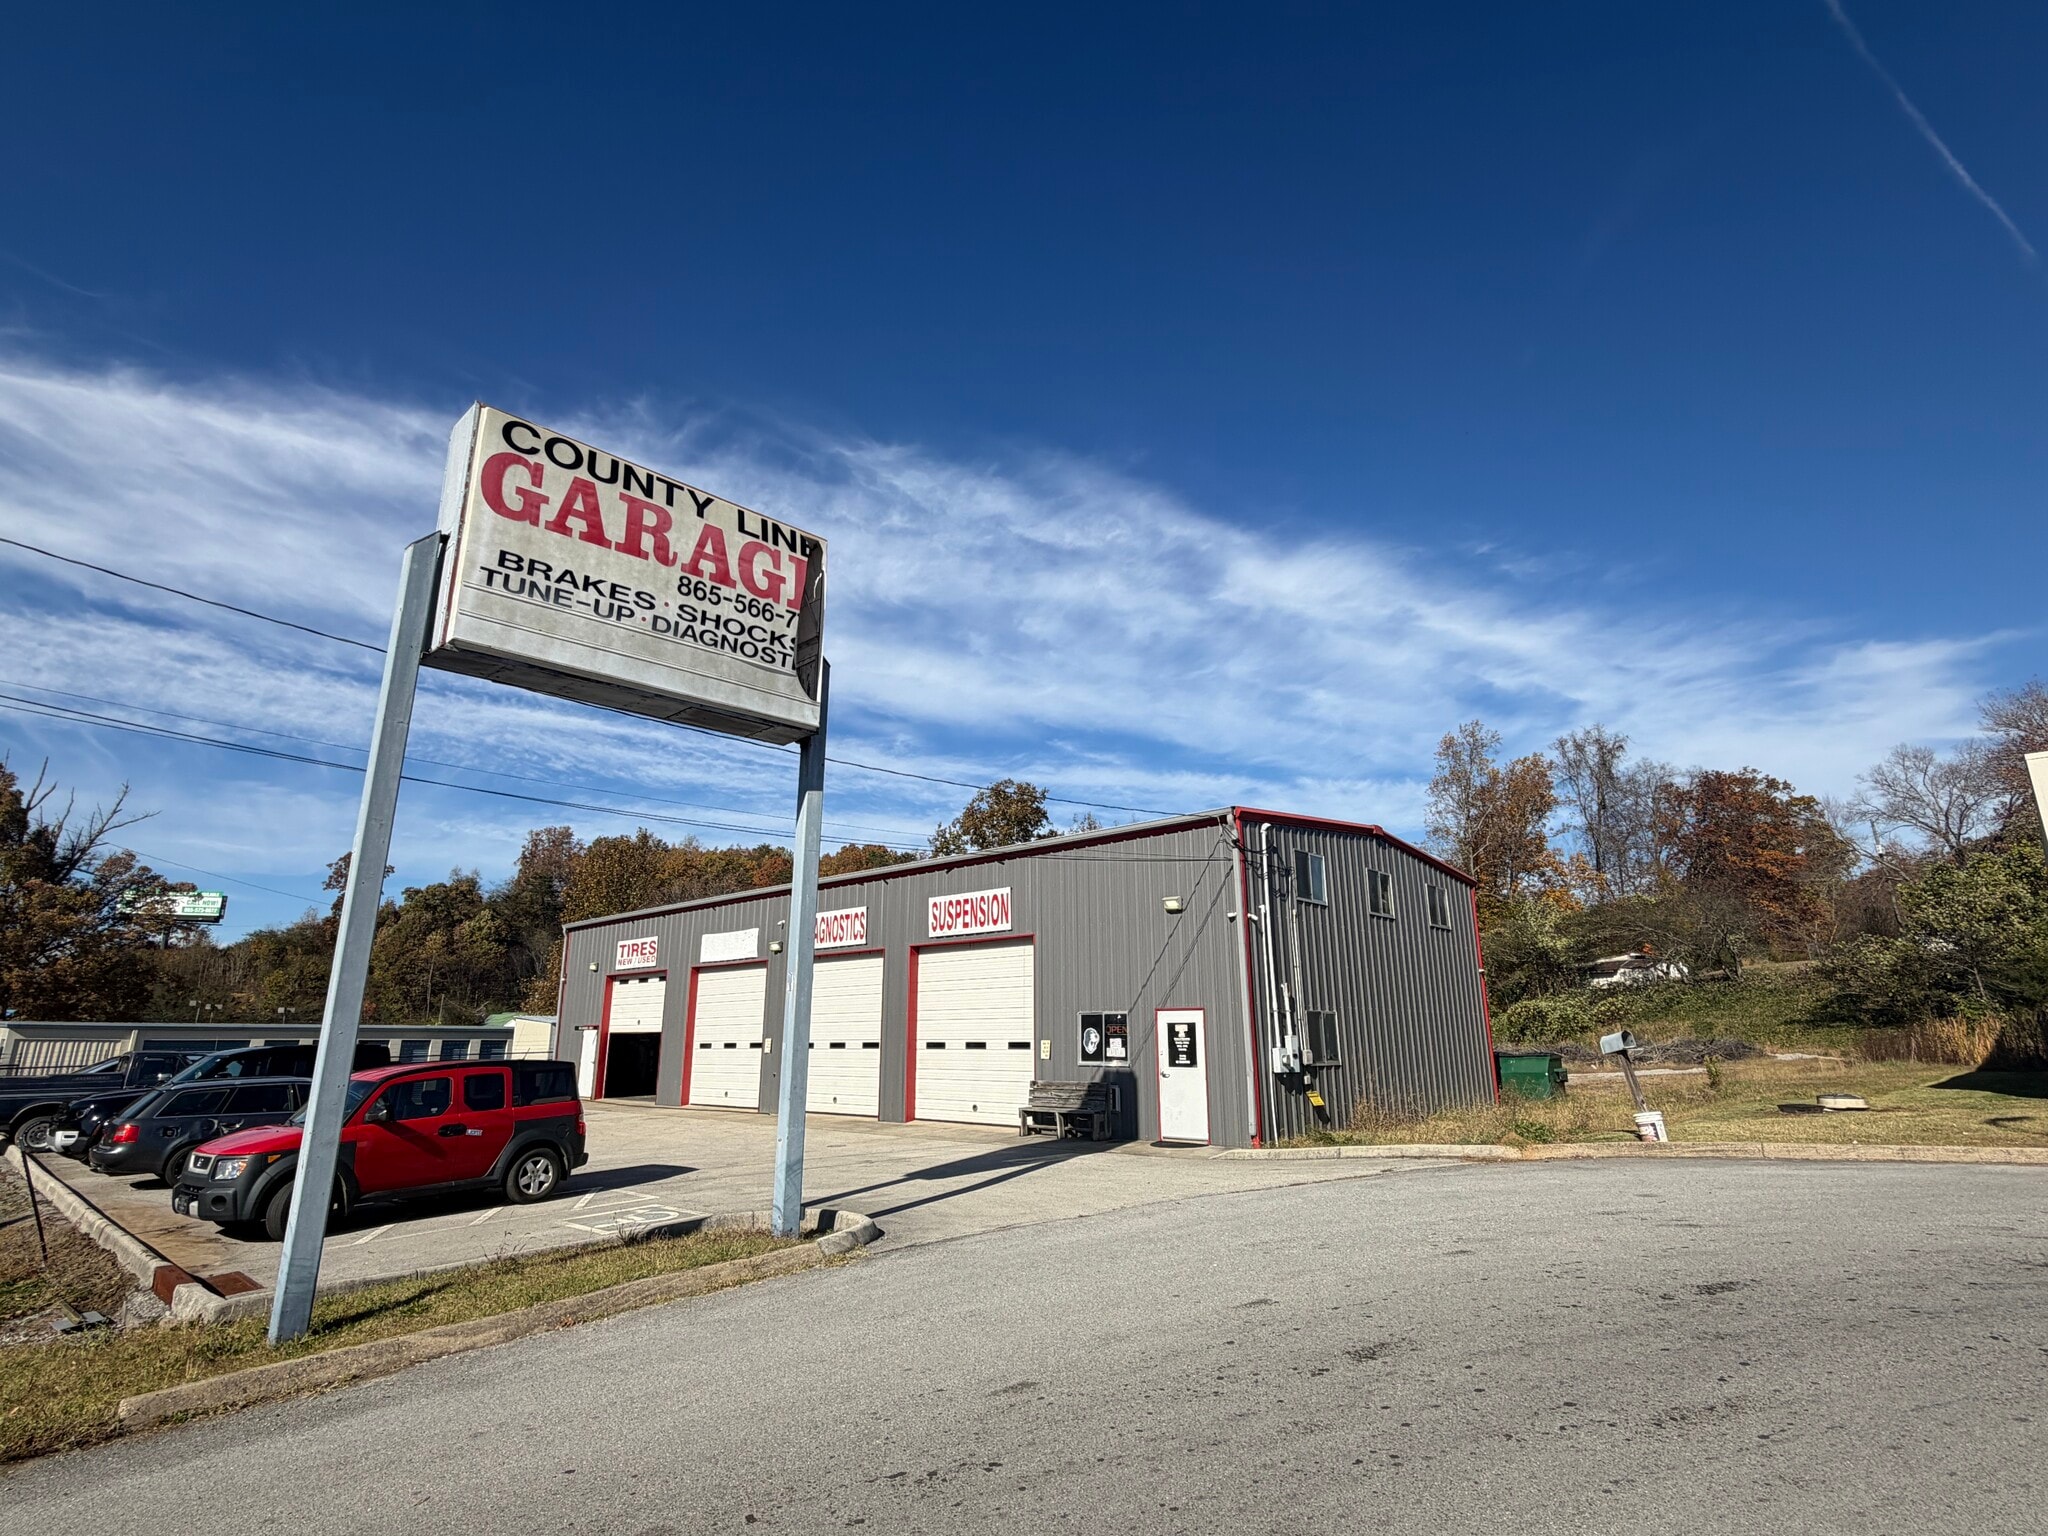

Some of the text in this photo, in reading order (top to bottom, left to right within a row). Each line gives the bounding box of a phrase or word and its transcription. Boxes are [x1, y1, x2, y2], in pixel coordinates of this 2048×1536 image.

[502, 420, 715, 519] COUNTY
[480, 566, 636, 622] TUNE-UP
[498, 549, 657, 611] BRAKES
[677, 575, 800, 628] 865-566-7
[931, 893, 1010, 932] SUSPENSION
[619, 940, 656, 958] TIRES
[638, 955, 655, 963] USED
